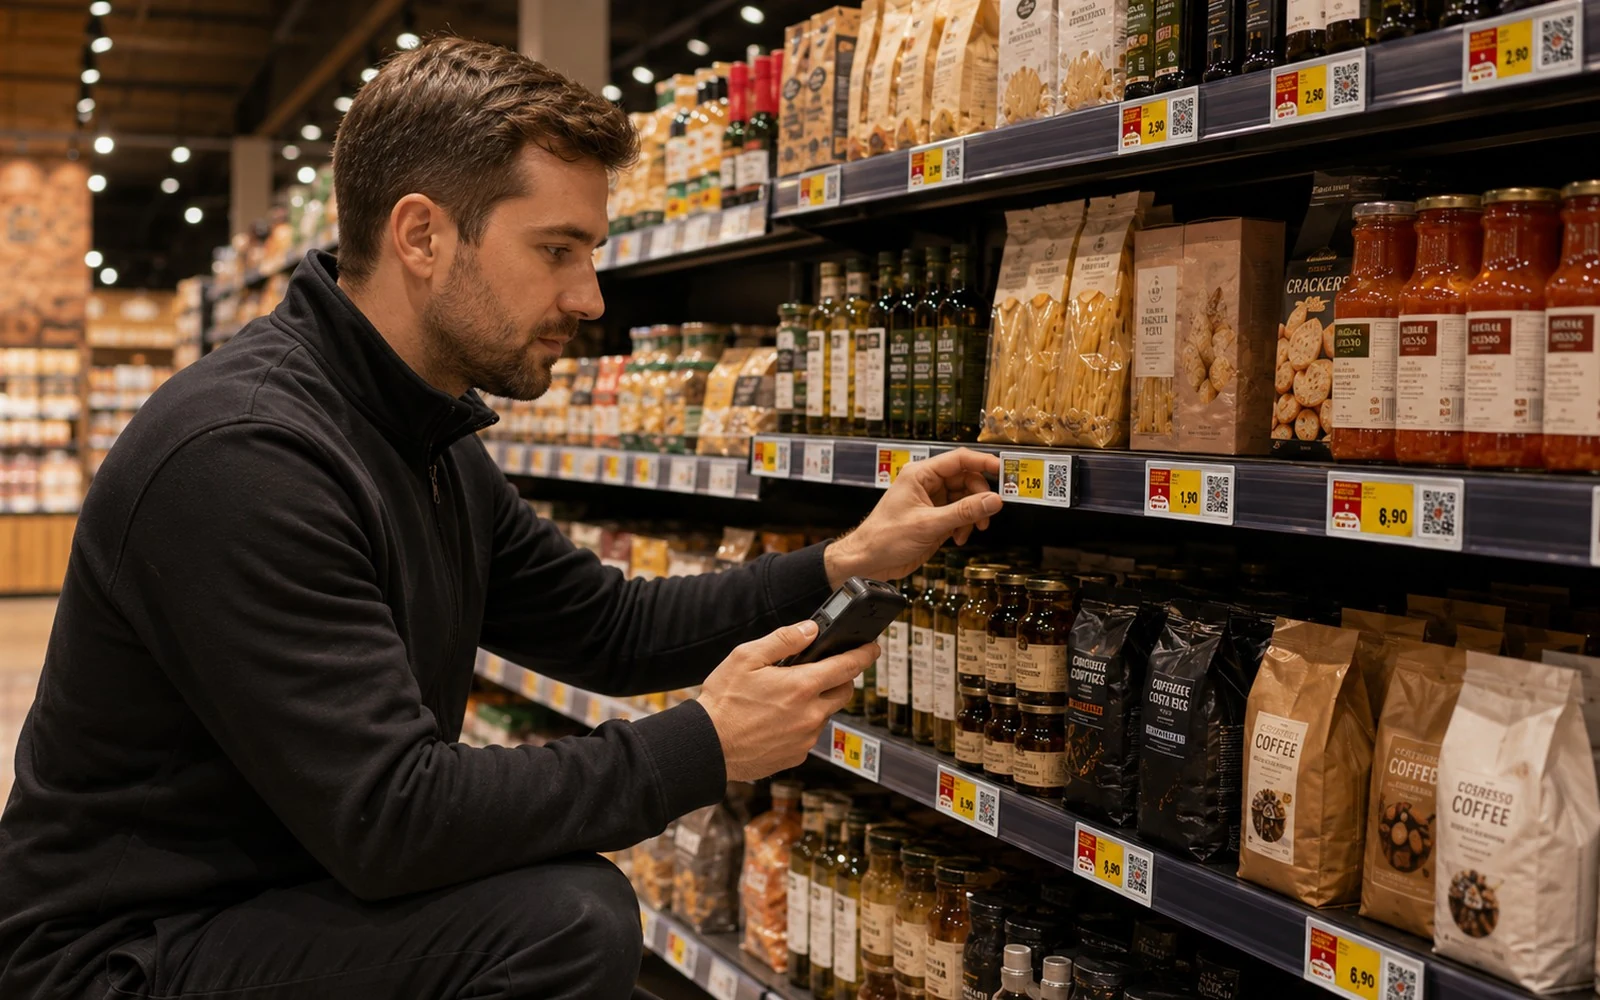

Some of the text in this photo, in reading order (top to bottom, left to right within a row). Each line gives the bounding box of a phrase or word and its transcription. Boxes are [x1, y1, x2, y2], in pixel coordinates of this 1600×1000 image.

[1255, 733, 1298, 759] COFFEE
[1389, 756, 1438, 785] COFFEE
[1452, 795, 1511, 828] COFFEE
